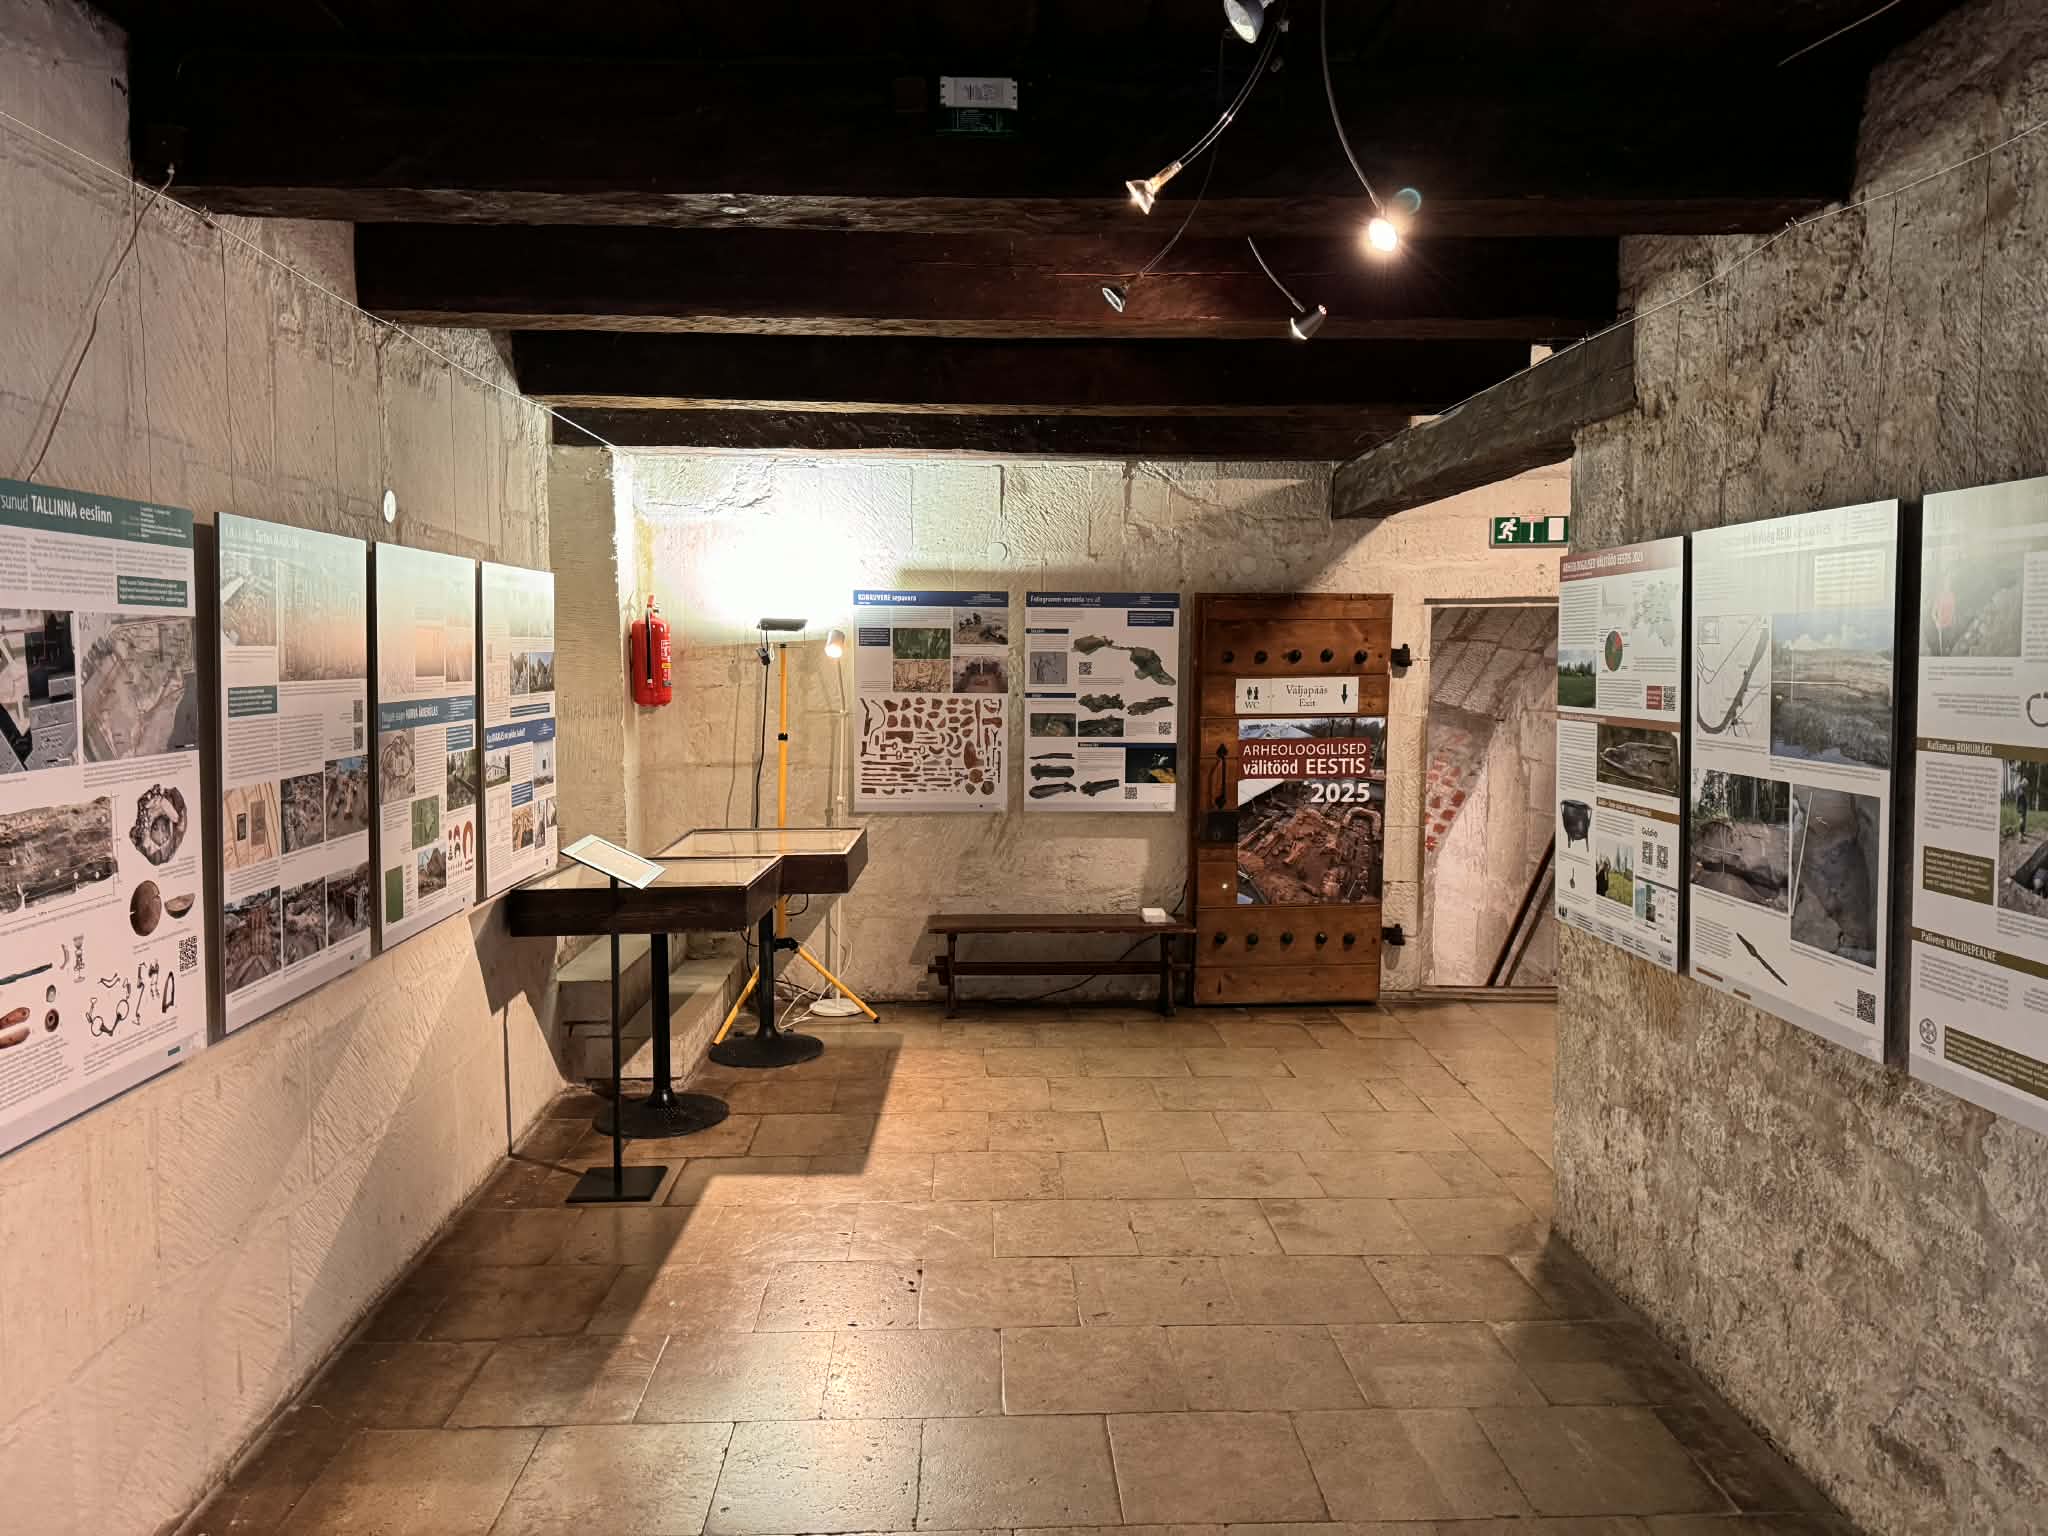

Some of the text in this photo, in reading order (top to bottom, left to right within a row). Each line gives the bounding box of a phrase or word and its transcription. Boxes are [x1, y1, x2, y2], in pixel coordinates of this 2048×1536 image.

[31, 496, 77, 519] TALLINNA
[80, 504, 112, 524] eeslinn
[1244, 701, 1260, 709] WC
[1299, 698, 1316, 707] Exit
[1243, 743, 1367, 756] ARHEOLOOGILISED
[1243, 758, 1366, 775] välitööd EESTIS
[1310, 782, 1370, 803] 2025
